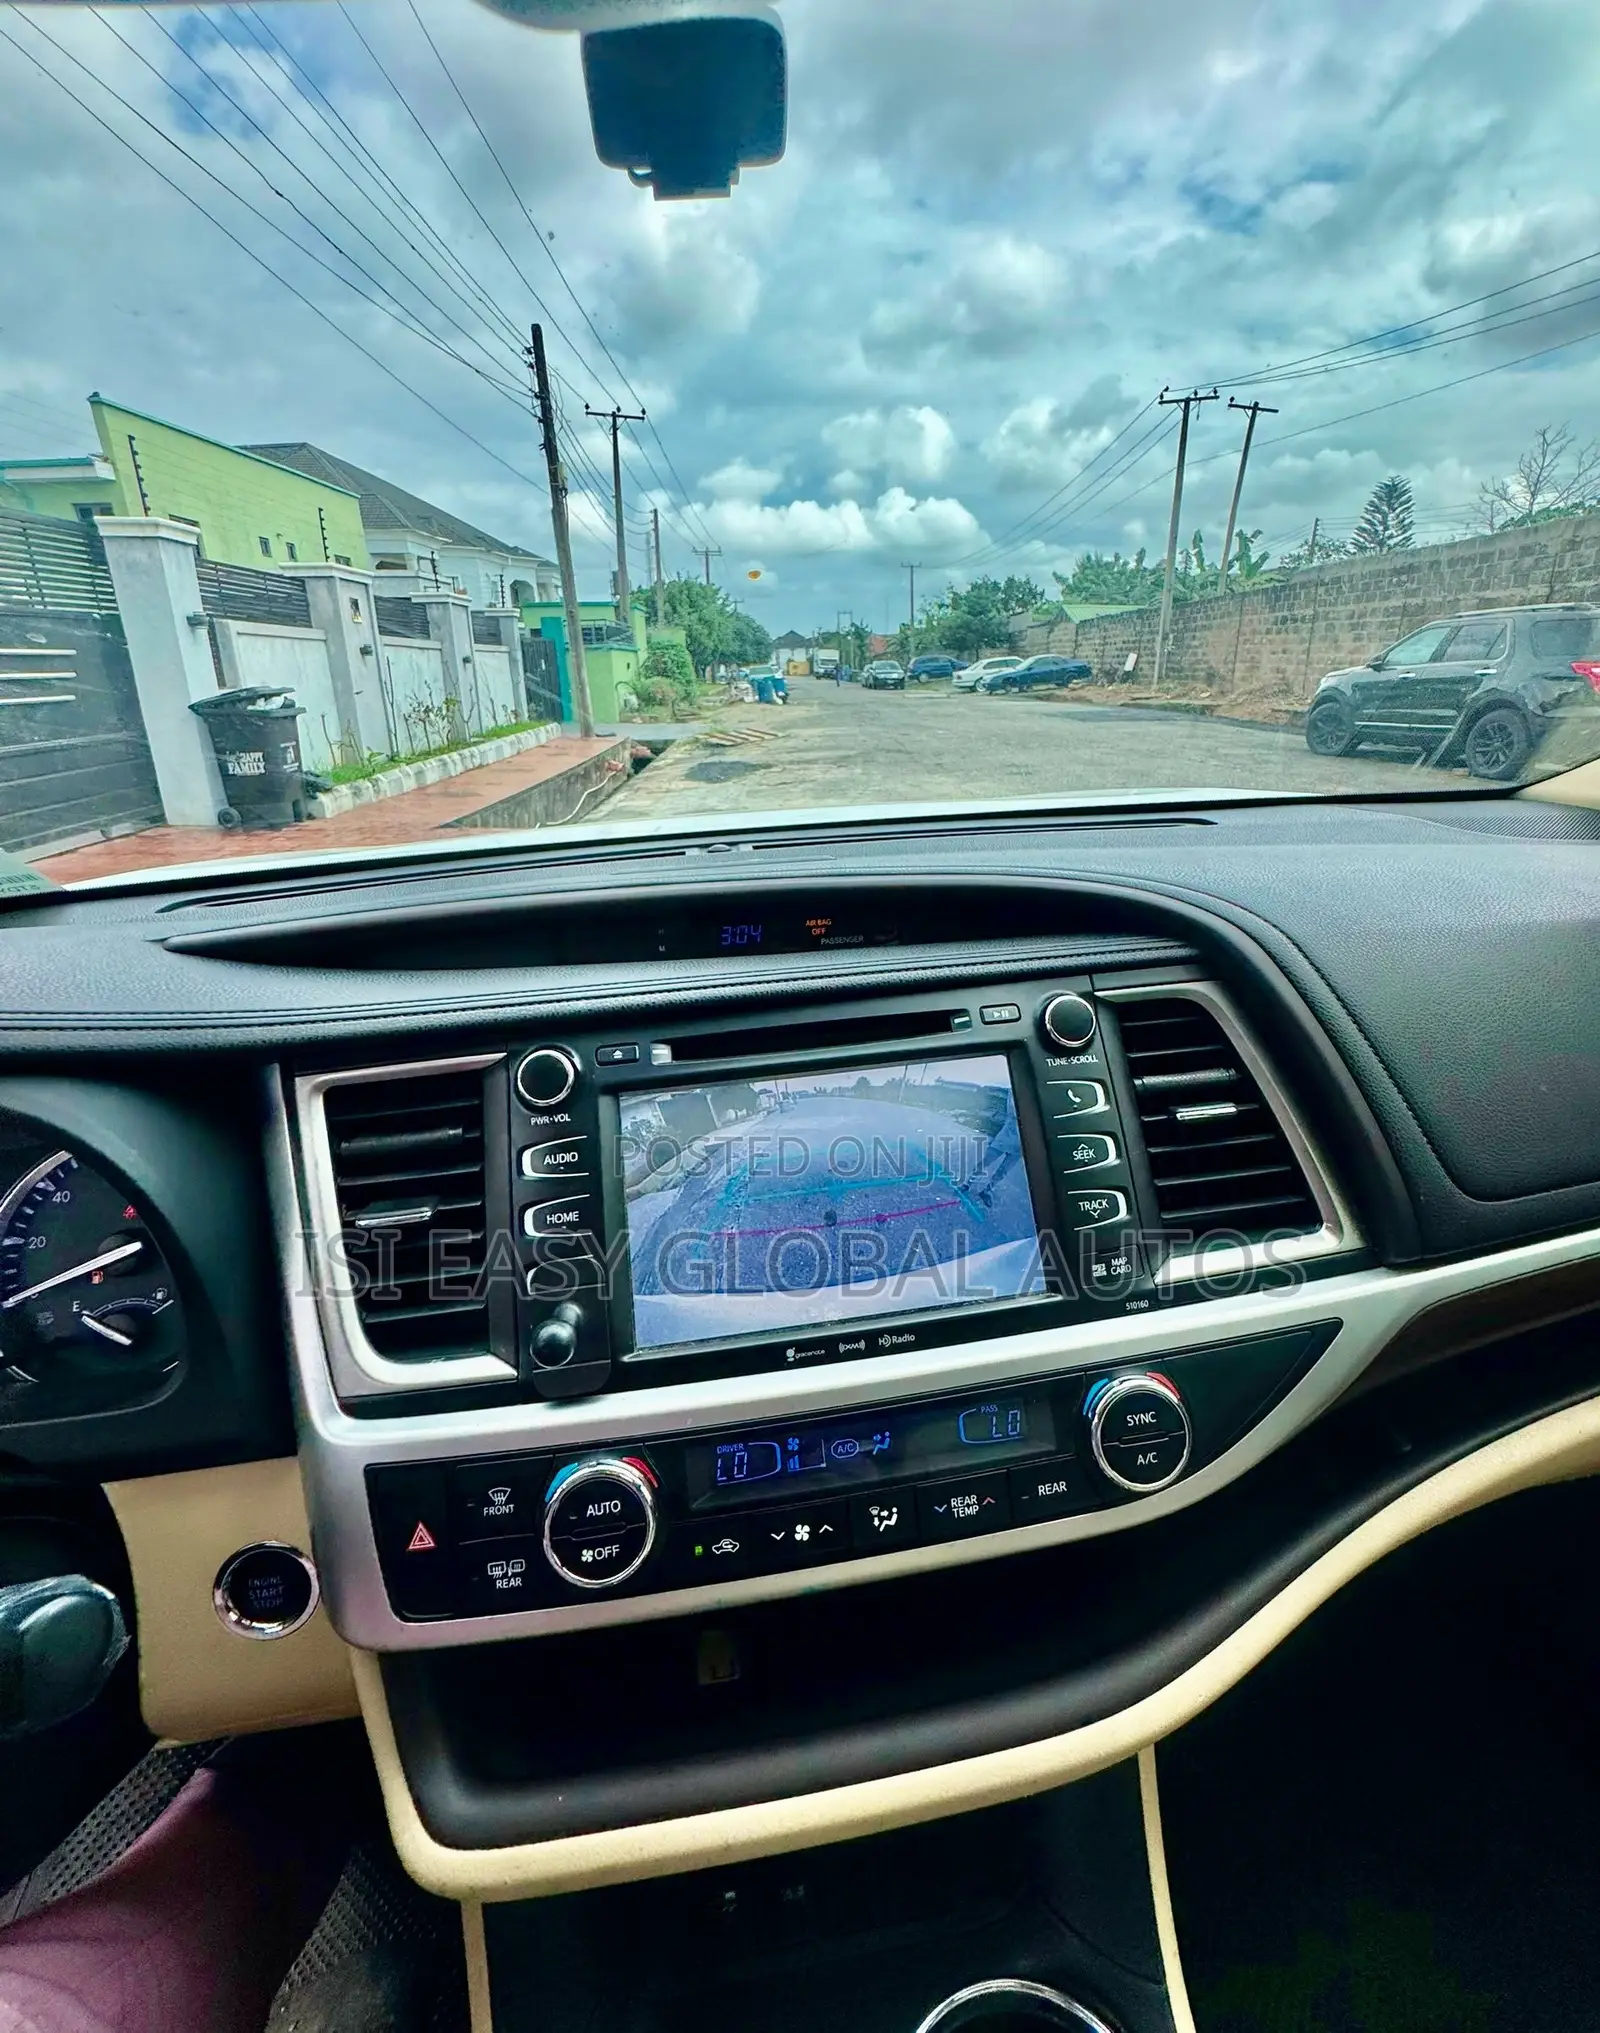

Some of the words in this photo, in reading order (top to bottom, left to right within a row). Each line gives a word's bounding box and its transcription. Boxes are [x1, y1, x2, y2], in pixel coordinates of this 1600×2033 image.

[721, 925, 762, 945] 3:04
[811, 928, 827, 936] OFF
[820, 935, 864, 945] PASSENGER
[543, 1152, 579, 1165] AUDIO
[1072, 1149, 1096, 1161] SEEK
[52, 1190, 71, 1203] 40
[1078, 1199, 1109, 1212] TRACK
[546, 1211, 580, 1225] HOME
[28, 1236, 46, 1250] 20
[1111, 1257, 1128, 1266] MAP
[1110, 1264, 1132, 1275] CARD
[72, 1300, 81, 1312] E
[1125, 1299, 1150, 1311] 510160
[795, 1348, 826, 1359] gracenote
[980, 1404, 999, 1414] PASS
[1126, 1410, 1158, 1427] SYNC
[716, 1443, 745, 1454] DRIVER
[836, 1443, 855, 1454] A/C
[1136, 1451, 1159, 1466] A/C
[1038, 1481, 1068, 1497] REAR
[950, 1494, 979, 1508] REAR
[483, 1503, 515, 1516] FRONT
[585, 1499, 622, 1518] AUTO
[952, 1503, 980, 1518] TEMP
[594, 1544, 621, 1561] OFF
[496, 1576, 523, 1589] REAR
[248, 1585, 285, 1600] START
[252, 1597, 284, 1609] STOP
